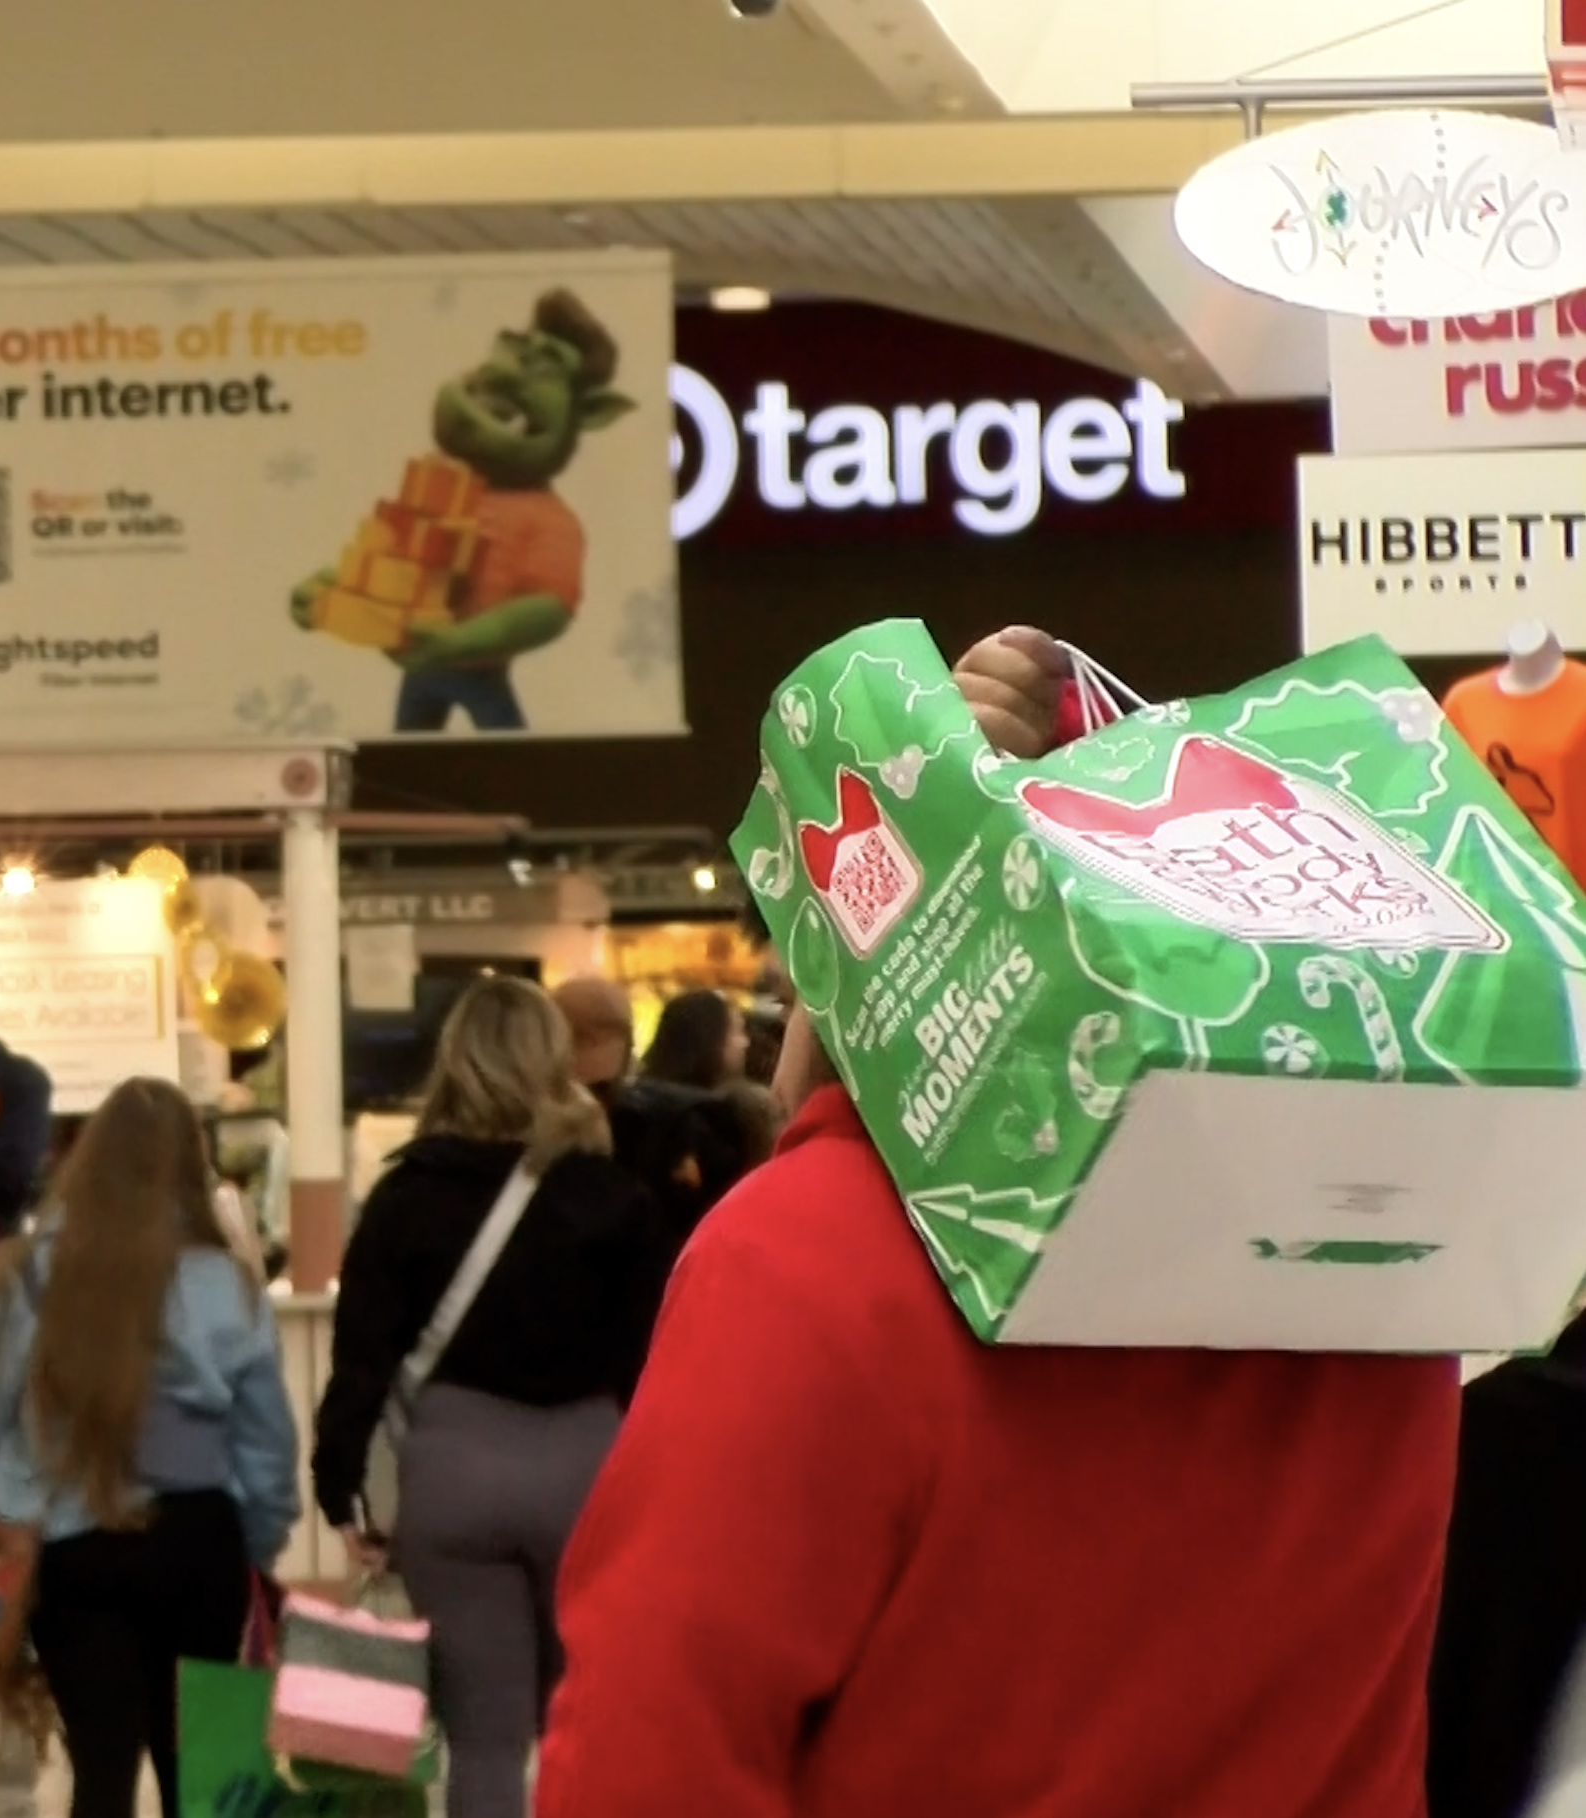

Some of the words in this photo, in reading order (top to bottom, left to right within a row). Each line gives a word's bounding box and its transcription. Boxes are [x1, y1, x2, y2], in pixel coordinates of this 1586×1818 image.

[175, 309, 235, 361] of
[247, 307, 368, 358] free
[42, 371, 291, 420] internet.
[1445, 358, 1586, 417] rus
[745, 381, 1185, 536] target
[1310, 512, 1586, 566] HIBBETT
[900, 944, 1035, 1149] MOMENTS
[914, 979, 971, 1059] BIG
